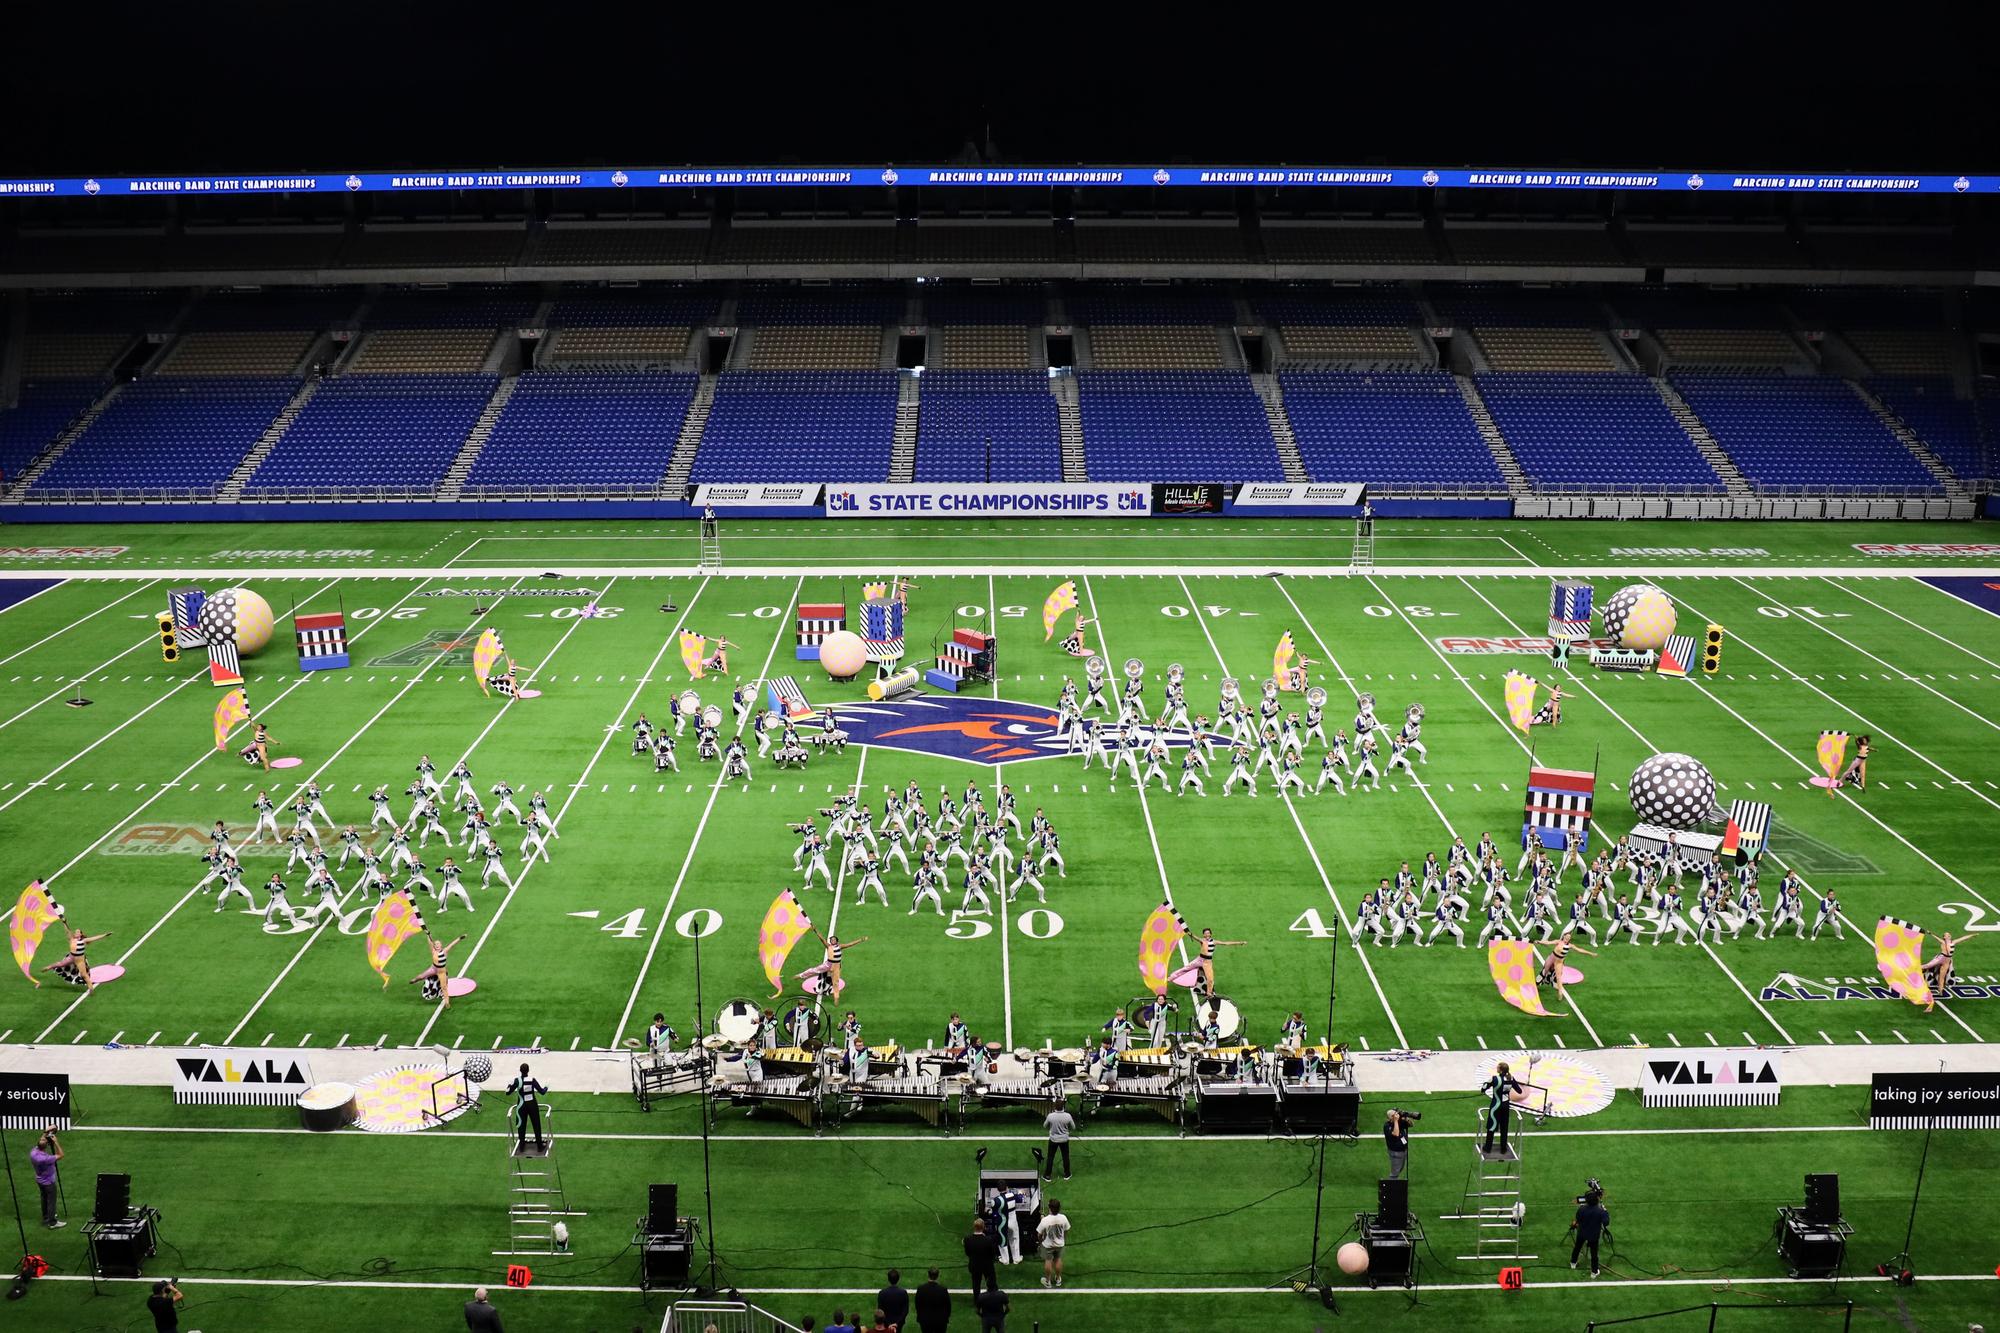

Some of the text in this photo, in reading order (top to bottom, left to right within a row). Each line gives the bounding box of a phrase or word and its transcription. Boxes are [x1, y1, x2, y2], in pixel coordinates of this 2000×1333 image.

[391, 175, 580, 187] MARCHING BAND STATE CHAMPIONSHIPS
[658, 172, 850, 183] MARCHING BAND STATE CHAMPIONSHIPS
[929, 172, 1122, 181] MARCHING BAND STATE CHAMPIONSHIPS
[1200, 172, 1391, 182] MARCHING BAND STATE CHAMPIONSHIPS
[1469, 174, 1657, 186] MARCHING BAND STATE CHAMPIONSHIPS
[1732, 177, 1919, 189] MARCHING BAND STATE CHAMPIONSHIPS
[130, 179, 315, 191] MARCHING BAND STATE CHAMPIONSHIPS
[869, 494, 932, 511] STATE
[938, 493, 1109, 511] CHAMPIONSHIPS
[176, 1058, 306, 1084] WALALA
[1648, 1060, 1779, 1085] WALALA
[7, 1086, 66, 1105] seriously
[1874, 1086, 1917, 1104] taking
[1921, 1087, 1943, 1104] joy
[508, 1268, 526, 1286] 40
[1505, 1270, 1521, 1288] 40
